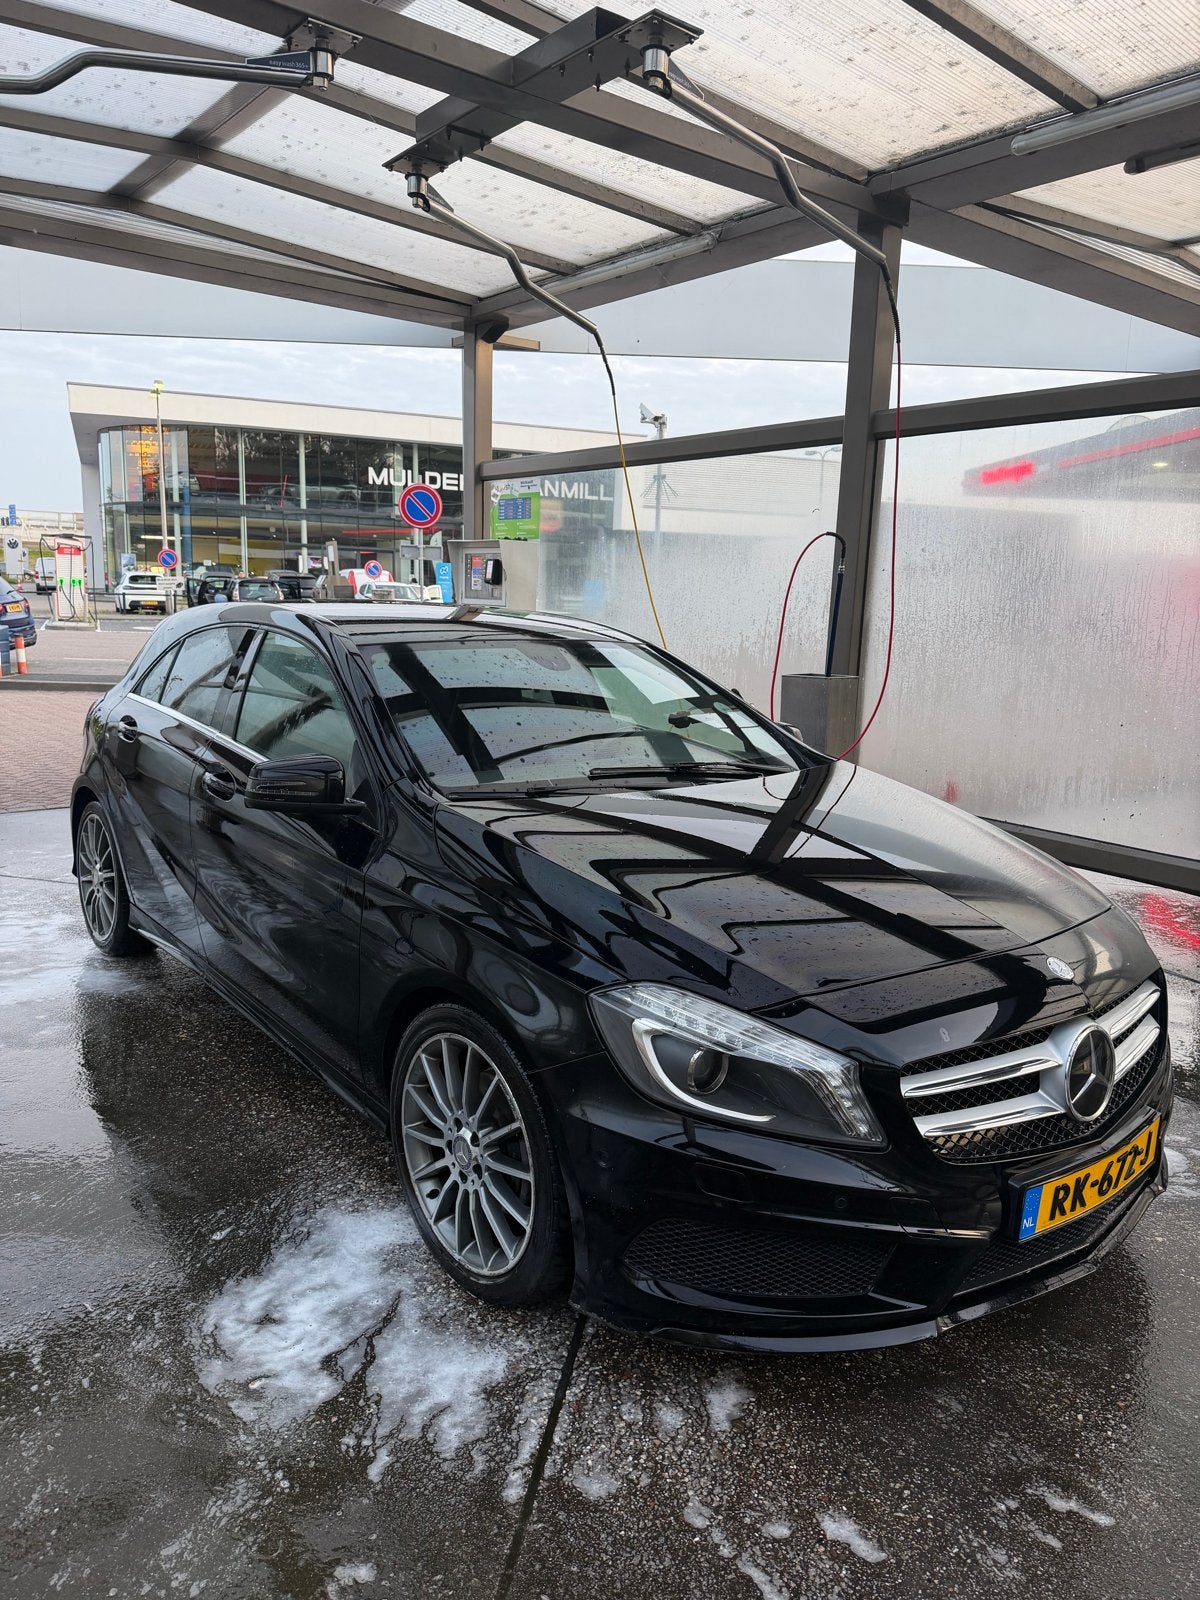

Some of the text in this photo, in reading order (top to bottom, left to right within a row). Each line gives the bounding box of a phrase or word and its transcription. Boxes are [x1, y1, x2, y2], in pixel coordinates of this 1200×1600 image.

[367, 466, 464, 491] MULDE
[540, 479, 614, 501] NMILL
[1048, 1130, 1153, 1222] RK-672-J
[1022, 1218, 1035, 1230] NL
